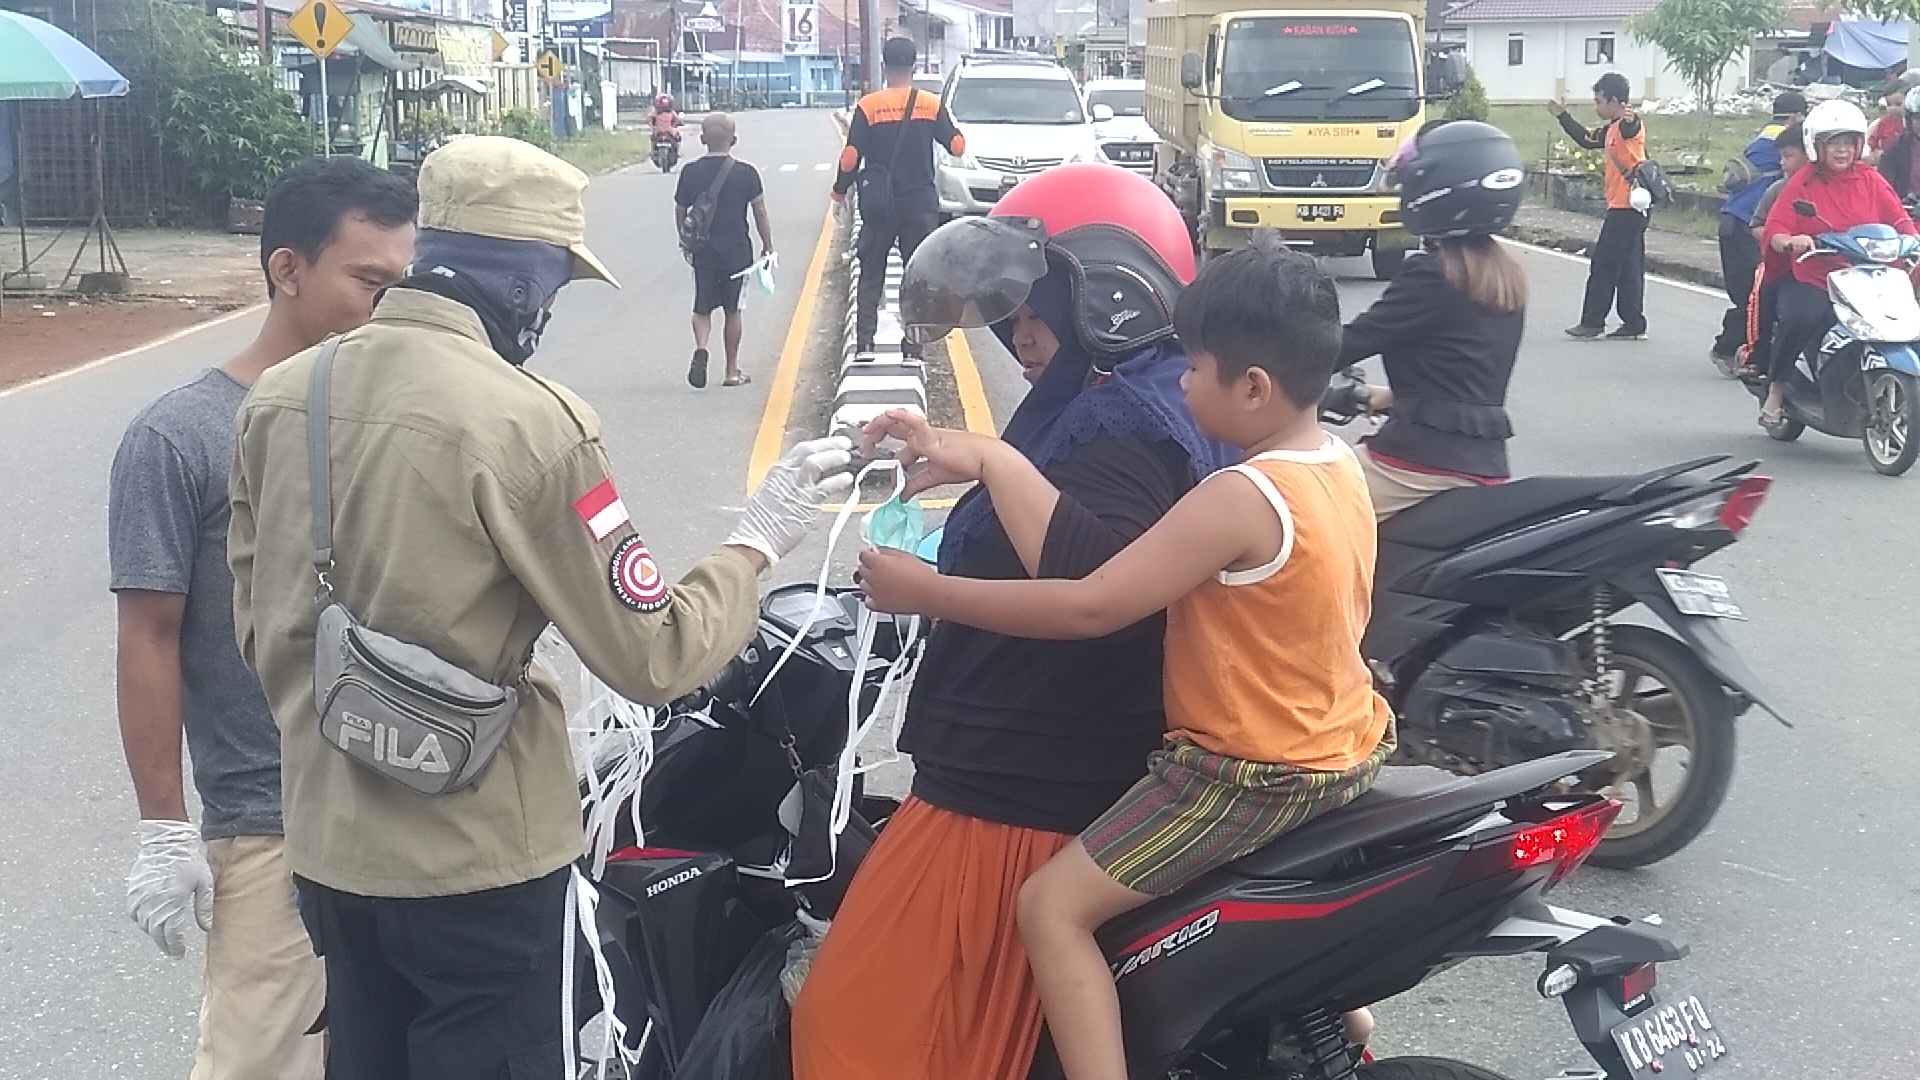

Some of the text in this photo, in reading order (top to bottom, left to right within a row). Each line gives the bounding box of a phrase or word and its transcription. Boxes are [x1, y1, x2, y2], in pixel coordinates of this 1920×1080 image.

[1314, 127, 1330, 137] IYA
[338, 722, 451, 773] FILA
[646, 866, 703, 897] HONDA
[1620, 1027, 1653, 1070] KB
[1645, 1006, 1688, 1056] 6463
